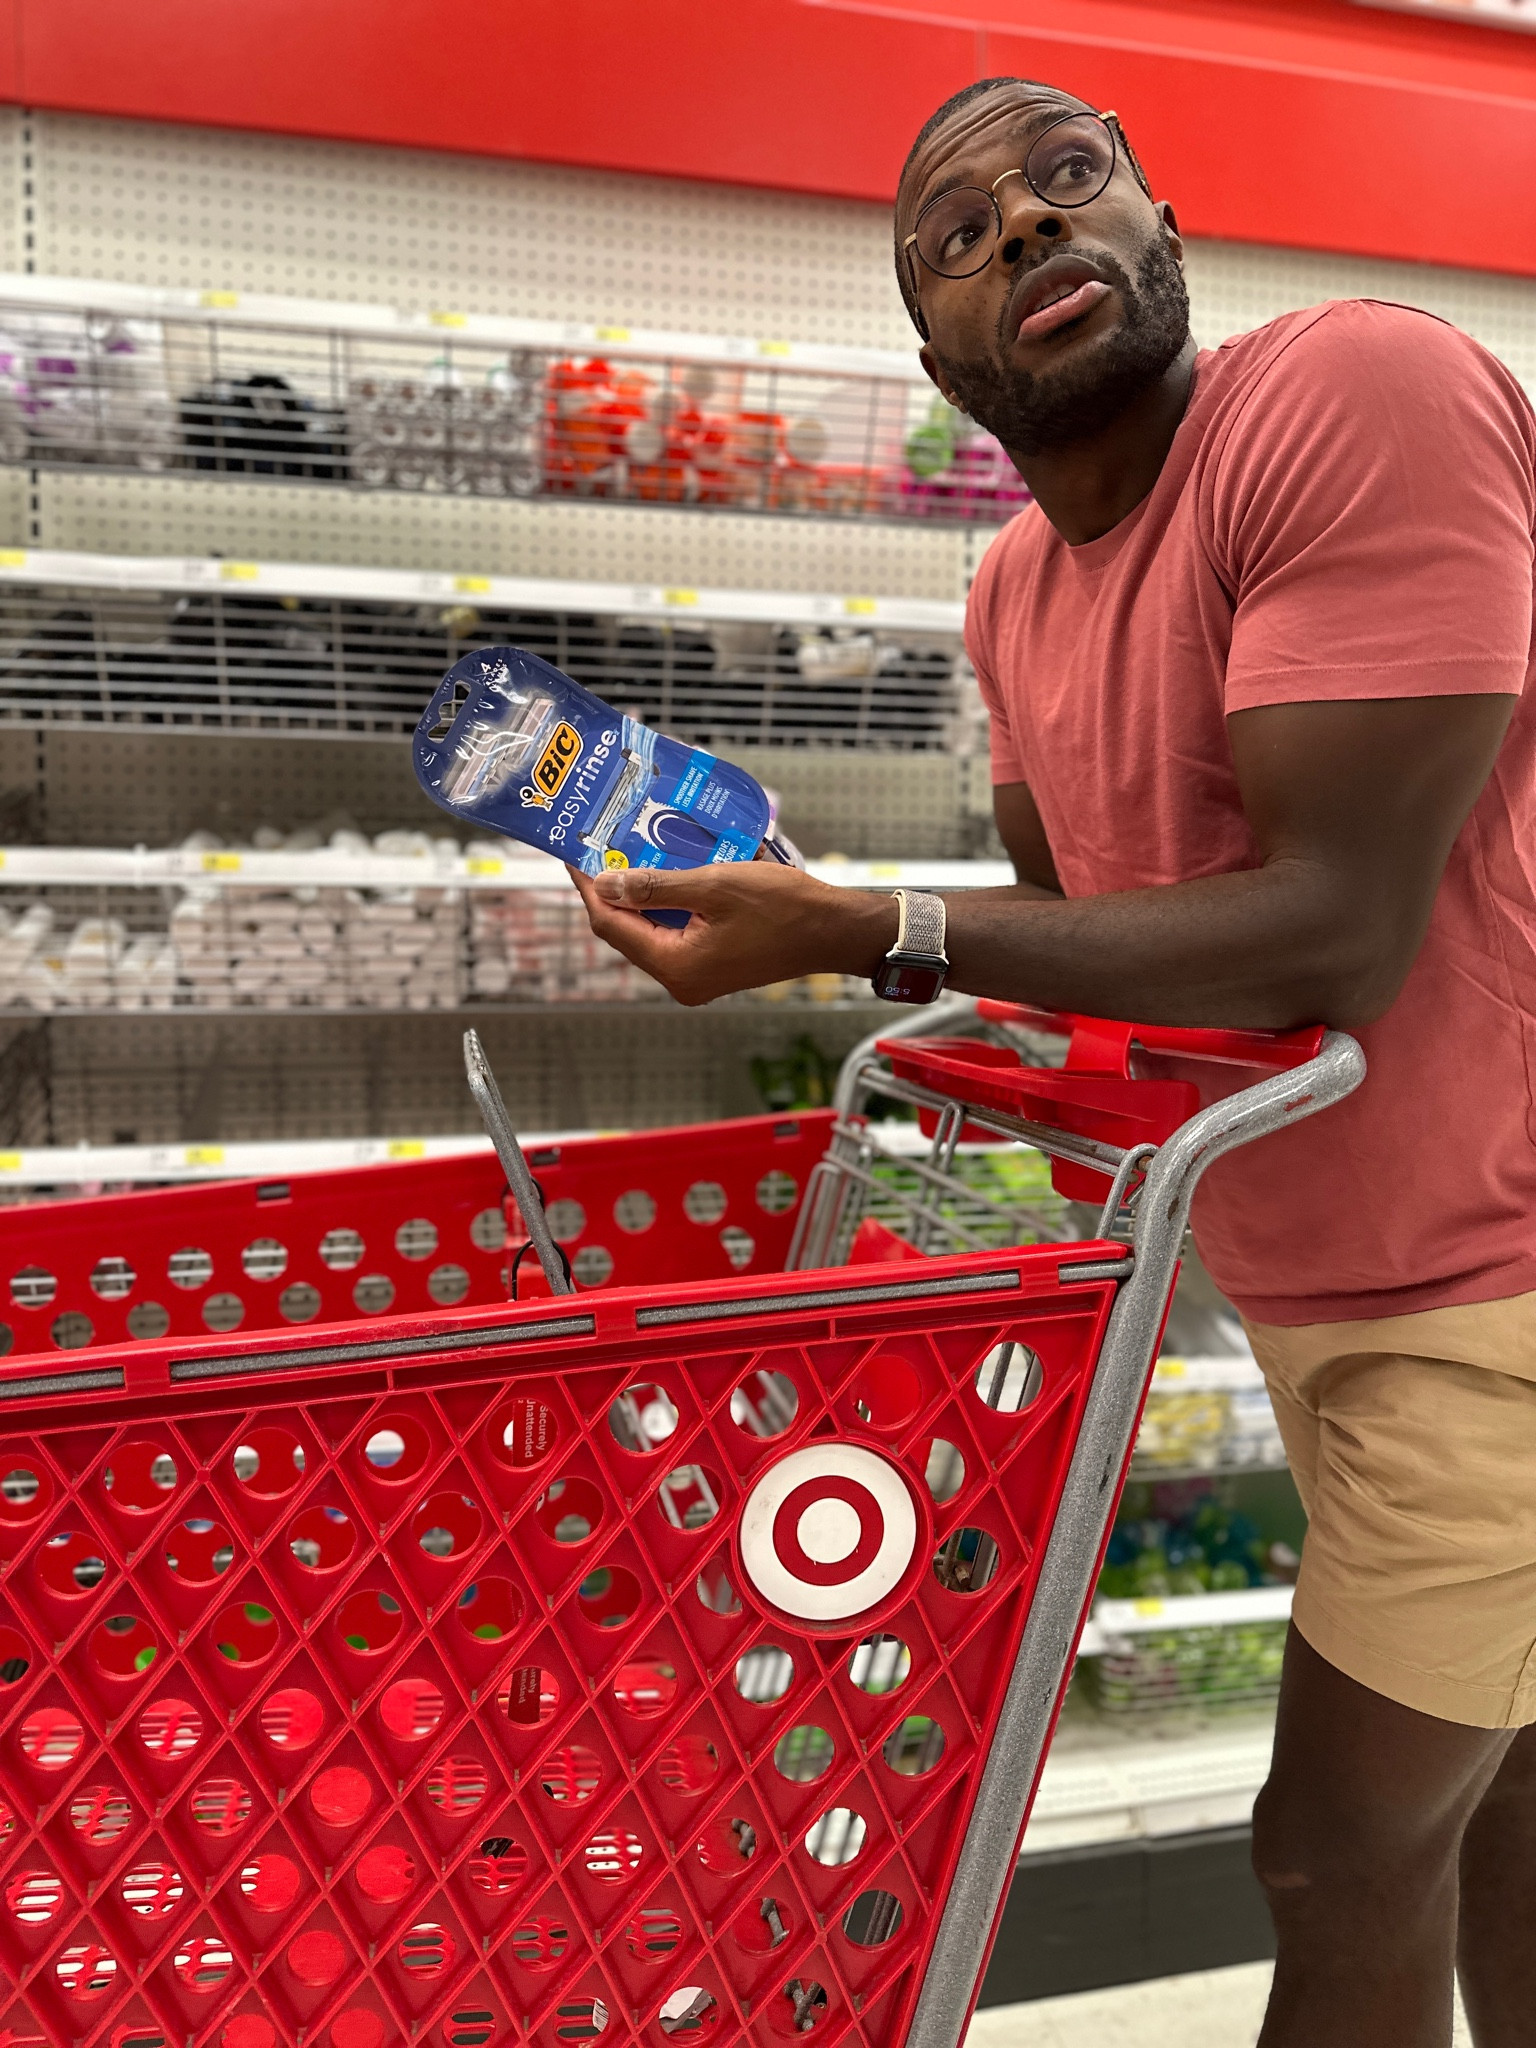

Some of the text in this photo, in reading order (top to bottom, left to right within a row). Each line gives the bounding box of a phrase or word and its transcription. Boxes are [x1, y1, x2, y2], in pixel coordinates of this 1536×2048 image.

[480, 662, 491, 673] 4
[550, 729, 617, 840] easyrinse
[673, 765, 698, 805] SMOOTHER SHAVE
[885, 986, 910, 995] 5:50
[536, 1404, 548, 1450] Securely
